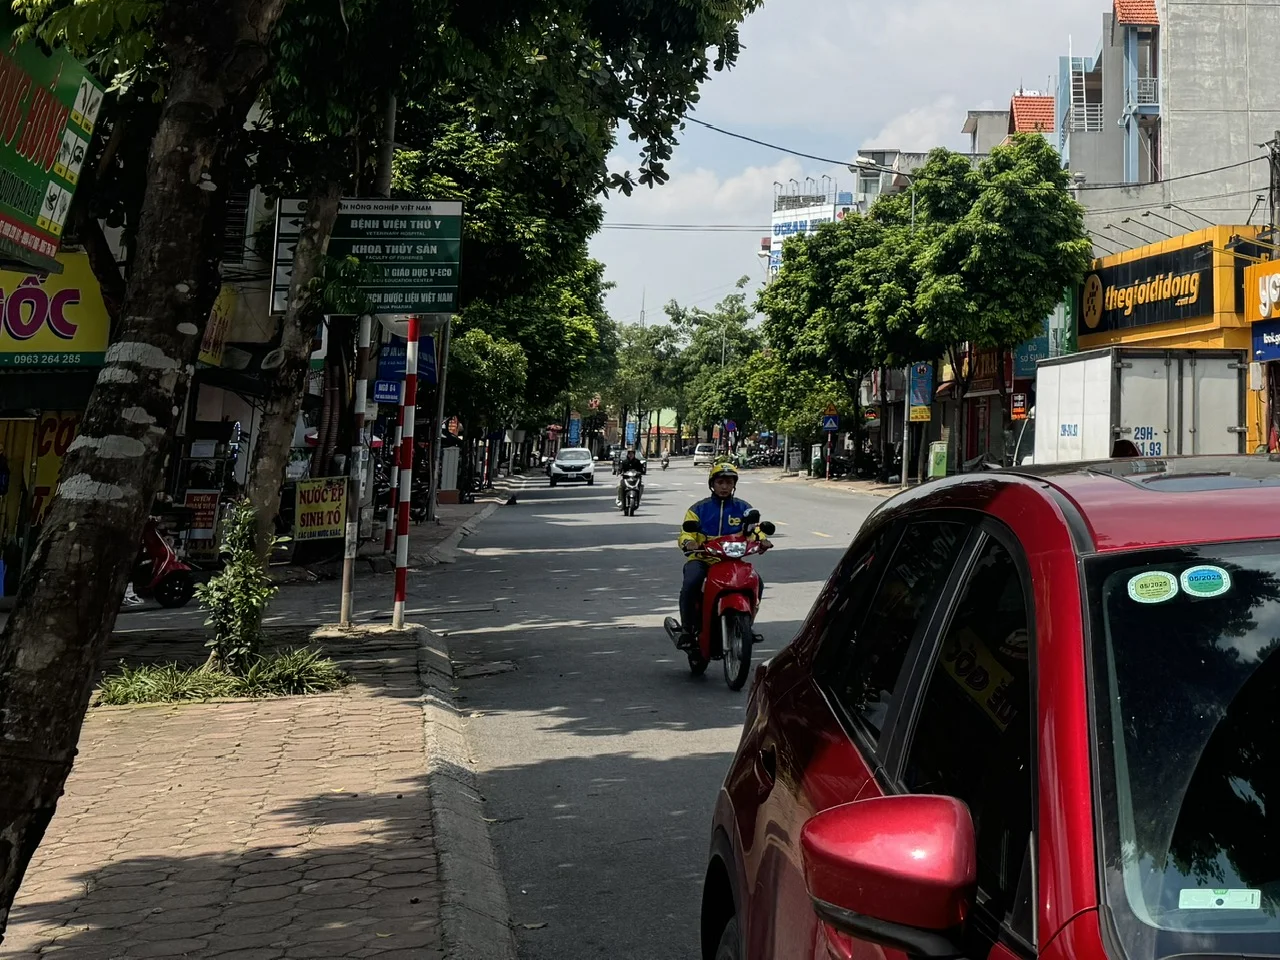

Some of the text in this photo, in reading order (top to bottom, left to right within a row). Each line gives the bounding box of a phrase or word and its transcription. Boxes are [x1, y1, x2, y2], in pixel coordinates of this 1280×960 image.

[401, 203, 414, 211] VIỆT
[350, 218, 379, 230] BỆNH
[382, 218, 407, 230] VIỆN
[434, 220, 442, 229] Y
[773, 220, 807, 236] OCEAN
[351, 243, 438, 254] KHOA THỦY SẢN
[391, 267, 410, 277] GIÁO
[411, 267, 428, 278] DỤC
[430, 268, 452, 277] V-ECO
[383, 291, 453, 304] DƯỢC LIỆU VIỆT NAM
[1105, 272, 1201, 316] thegioididong
[0, 275, 81, 340] ỐC
[14, 354, 81, 364] 0963 264 285
[1137, 442, 1162, 456] 1.93
[299, 485, 328, 504] NƯỚC
[300, 503, 341, 527] SINH TỐ
[728, 514, 741, 526] be
[1189, 573, 1222, 582] 05/2025
